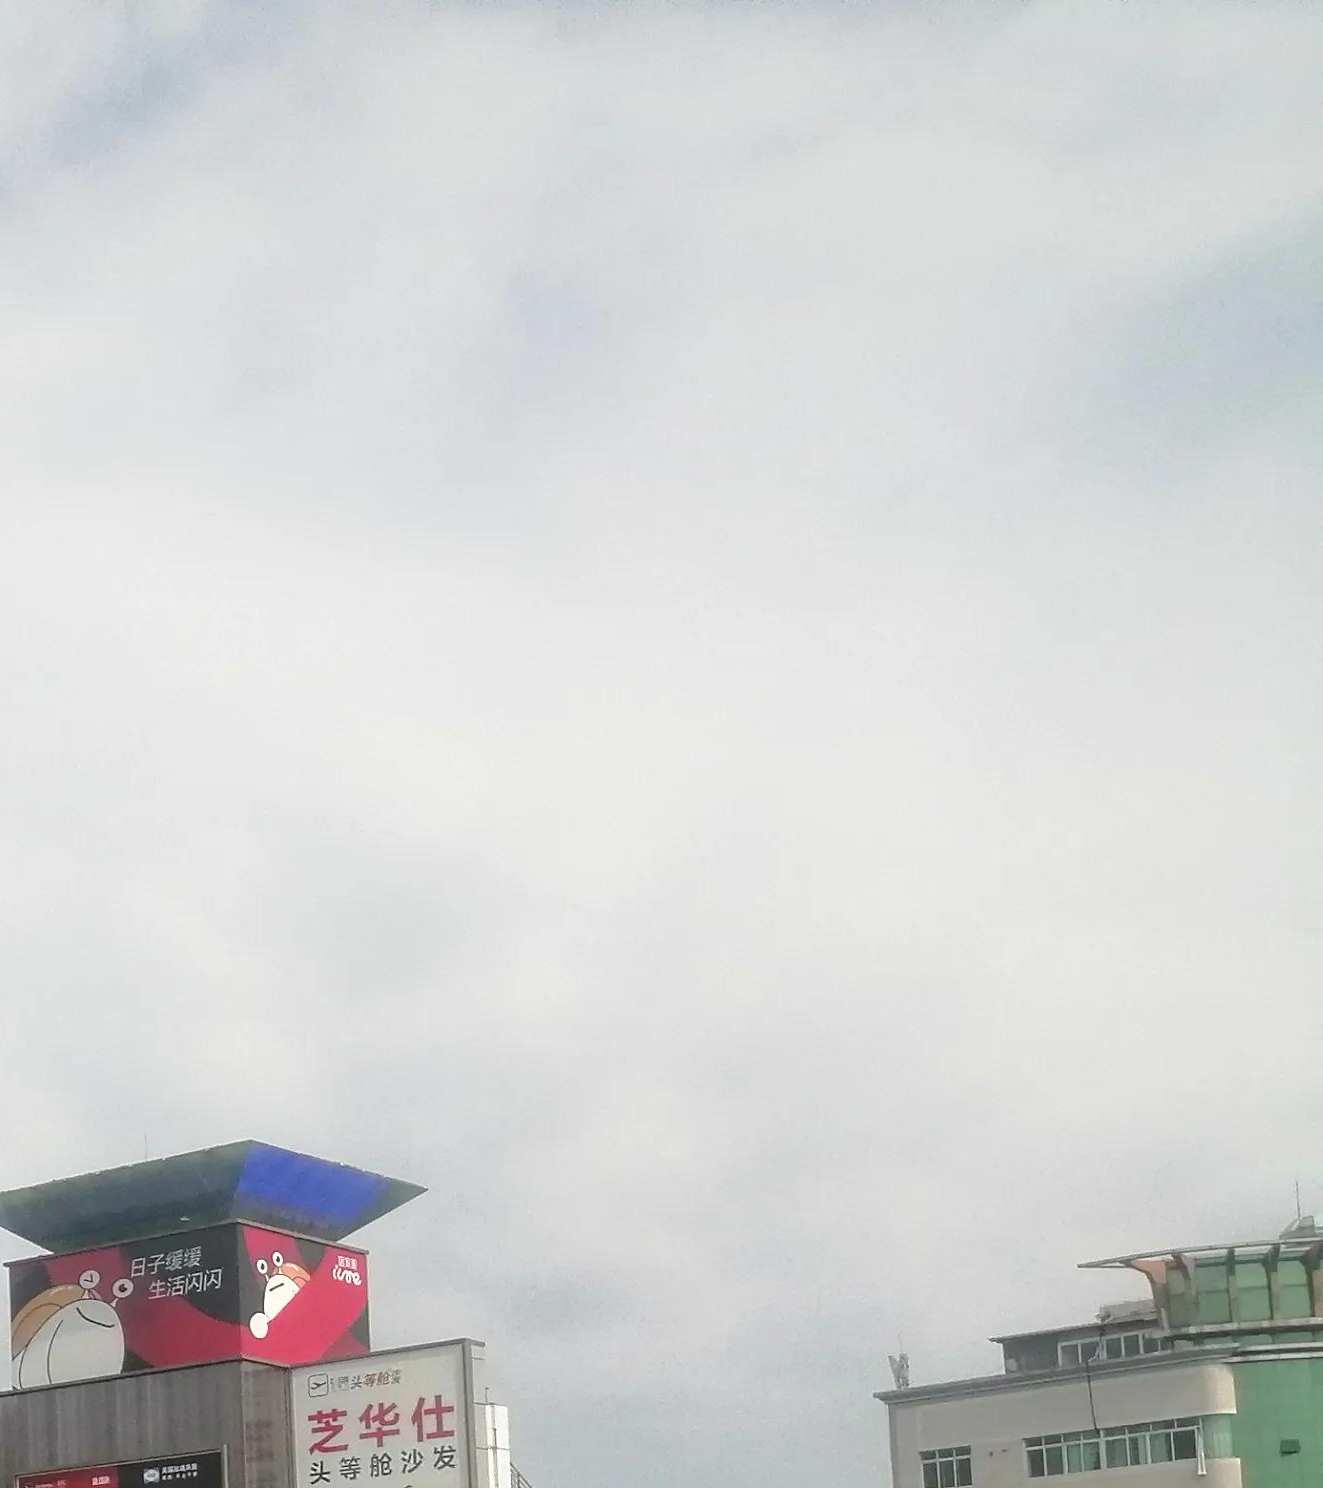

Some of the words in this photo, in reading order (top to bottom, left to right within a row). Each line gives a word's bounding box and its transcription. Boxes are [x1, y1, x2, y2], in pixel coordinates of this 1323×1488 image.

[131, 1246, 202, 1278] 日子缓缓
[148, 1268, 222, 1300] 生活闪闪
[308, 1394, 455, 1455] 芝华仕
[309, 1445, 457, 1485] 头等舱沙发
